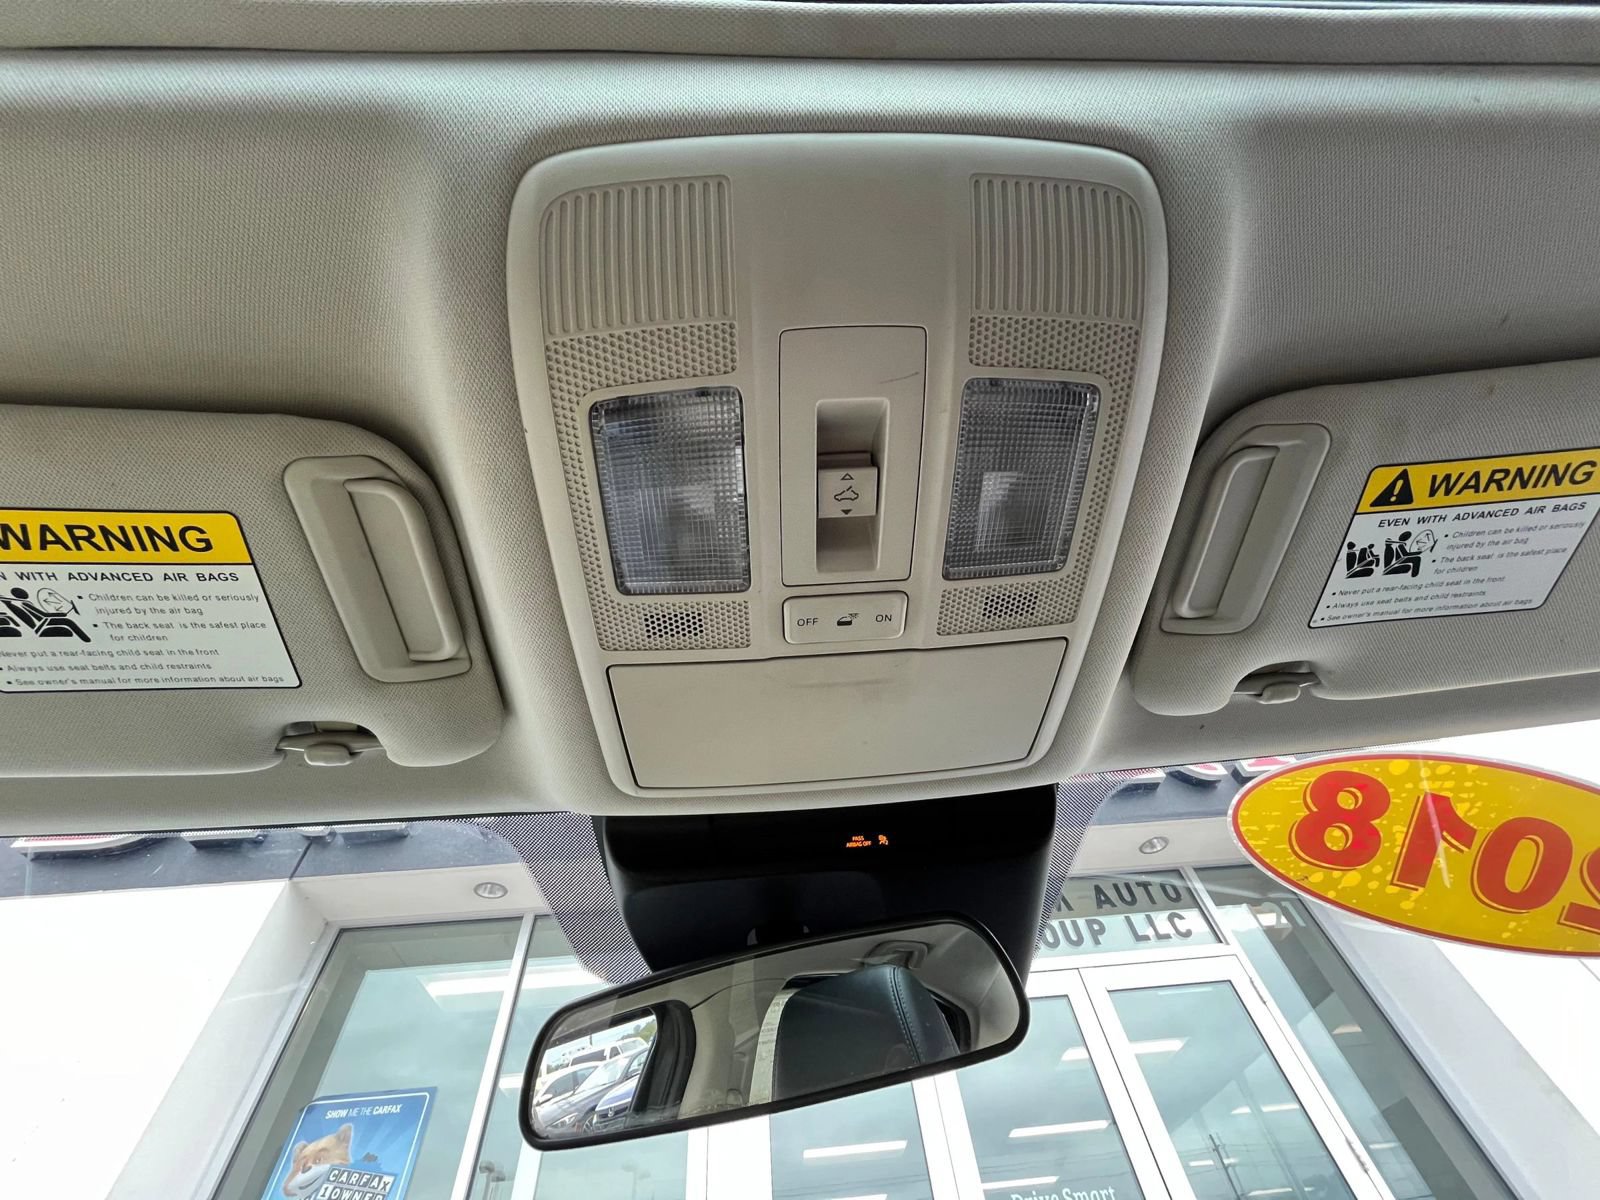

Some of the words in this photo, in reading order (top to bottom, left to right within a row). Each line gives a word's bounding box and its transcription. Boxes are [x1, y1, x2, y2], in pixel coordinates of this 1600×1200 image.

[1428, 460, 1597, 498] WARNING
[1378, 517, 1410, 528] EVEN
[1417, 513, 1447, 525] WITH
[1452, 507, 1519, 522] ADVANCED
[1525, 505, 1547, 515] AIR
[1552, 501, 1587, 513] BAGS
[1452, 530, 1486, 539] Children
[1548, 521, 1585, 530] seriously
[0, 523, 213, 552] WARNING
[1446, 542, 1474, 551] injured
[1475, 541, 1485, 549] by
[1514, 537, 1529, 545] bag
[1520, 549, 1545, 557] safest
[1545, 547, 1568, 556] place
[1446, 565, 1478, 574] children
[14, 571, 58, 581] WITH
[68, 572, 153, 581] ADVANCED
[163, 572, 188, 581] AIR
[196, 572, 239, 581] BAGS
[1382, 582, 1423, 593] rear-facing
[1424, 581, 1444, 589] child
[88, 593, 132, 602] Children
[157, 593, 170, 601] be
[172, 593, 199, 601] killed
[215, 593, 259, 603] seriously
[1451, 590, 1486, 599] restraints
[95, 606, 132, 615] injured
[135, 606, 147, 616] by
[150, 606, 166, 614] the
[169, 606, 181, 614] air
[184, 606, 203, 616] bag
[103, 621, 123, 629] The
[126, 621, 149, 629] back
[190, 621, 206, 629] the
[209, 621, 238, 629] safest
[241, 621, 267, 630] place
[797, 617, 819, 627] OFF
[875, 614, 892, 623] ON
[110, 634, 124, 642] for
[127, 633, 168, 641] children
[30, 650, 48, 659] put
[59, 649, 114, 658] rear-facing
[116, 648, 141, 656] child
[195, 648, 219, 656] front
[7, 665, 45, 673] Always
[91, 663, 117, 671] belts
[166, 662, 212, 670] restraints
[15, 678, 35, 686] See
[37, 678, 78, 686] owner's
[79, 677, 115, 685] manual
[161, 675, 216, 683] information
[218, 675, 245, 683] about
[261, 675, 284, 684] bags
[1093, 880, 1182, 909] AUTO
[1124, 911, 1193, 943] LLC
[325, 1108, 349, 1120] SHOW
[372, 1103, 403, 1115] CARFAX
[329, 1169, 391, 1191] CARFAX
